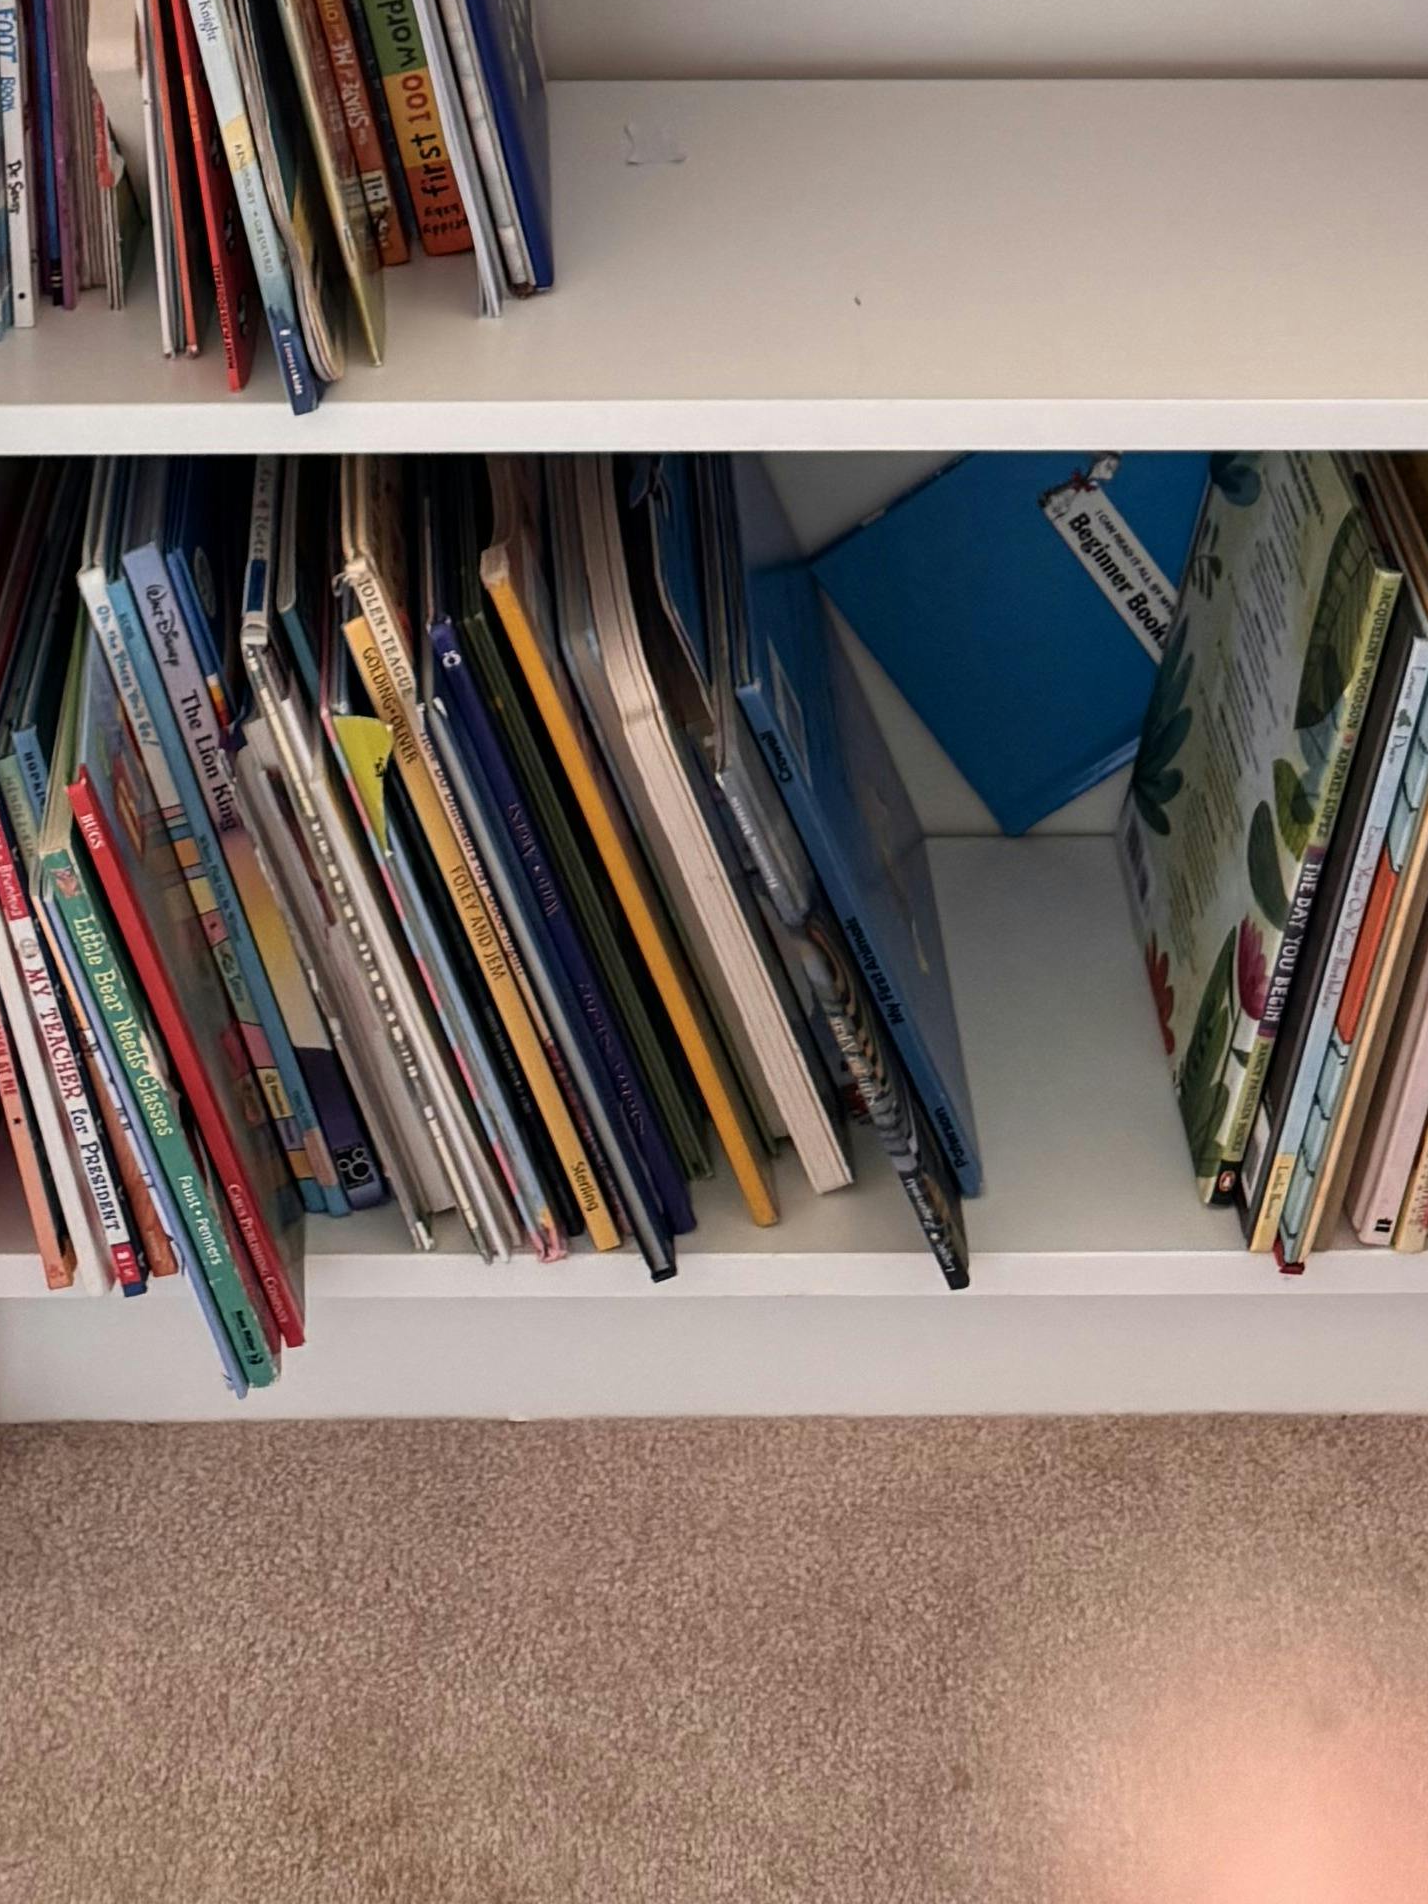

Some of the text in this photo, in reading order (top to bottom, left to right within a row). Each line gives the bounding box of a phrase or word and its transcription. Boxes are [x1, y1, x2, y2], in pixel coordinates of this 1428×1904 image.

[198, 0, 219, 43] Knight
[332, 40, 355, 67] ME
[1, 75, 17, 113] BOOK
[402, 75, 432, 124] 100
[410, 132, 451, 198] first
[1068, 511, 1135, 595] Beginner
[380, 634, 414, 696] TEAGUE
[179, 688, 203, 730] The
[192, 729, 220, 783] Lion
[211, 779, 239, 837] King
[80, 811, 106, 851] BUGS
[1261, 584, 1395, 1025] JACQUELINE WOODSON THE DAY YOU BEGIN
[845, 914, 883, 971] Animals
[25, 967, 54, 1004] MY
[38, 1006, 84, 1103] TEACHER
[72, 913, 174, 1140] Little Bear Needs Glasses
[449, 863, 601, 1213] FOLEY AND JEM Sterling
[67, 1105, 91, 1137] for
[79, 1139, 122, 1234] PRESIDENT
[178, 1175, 223, 1266] Faust Penners
